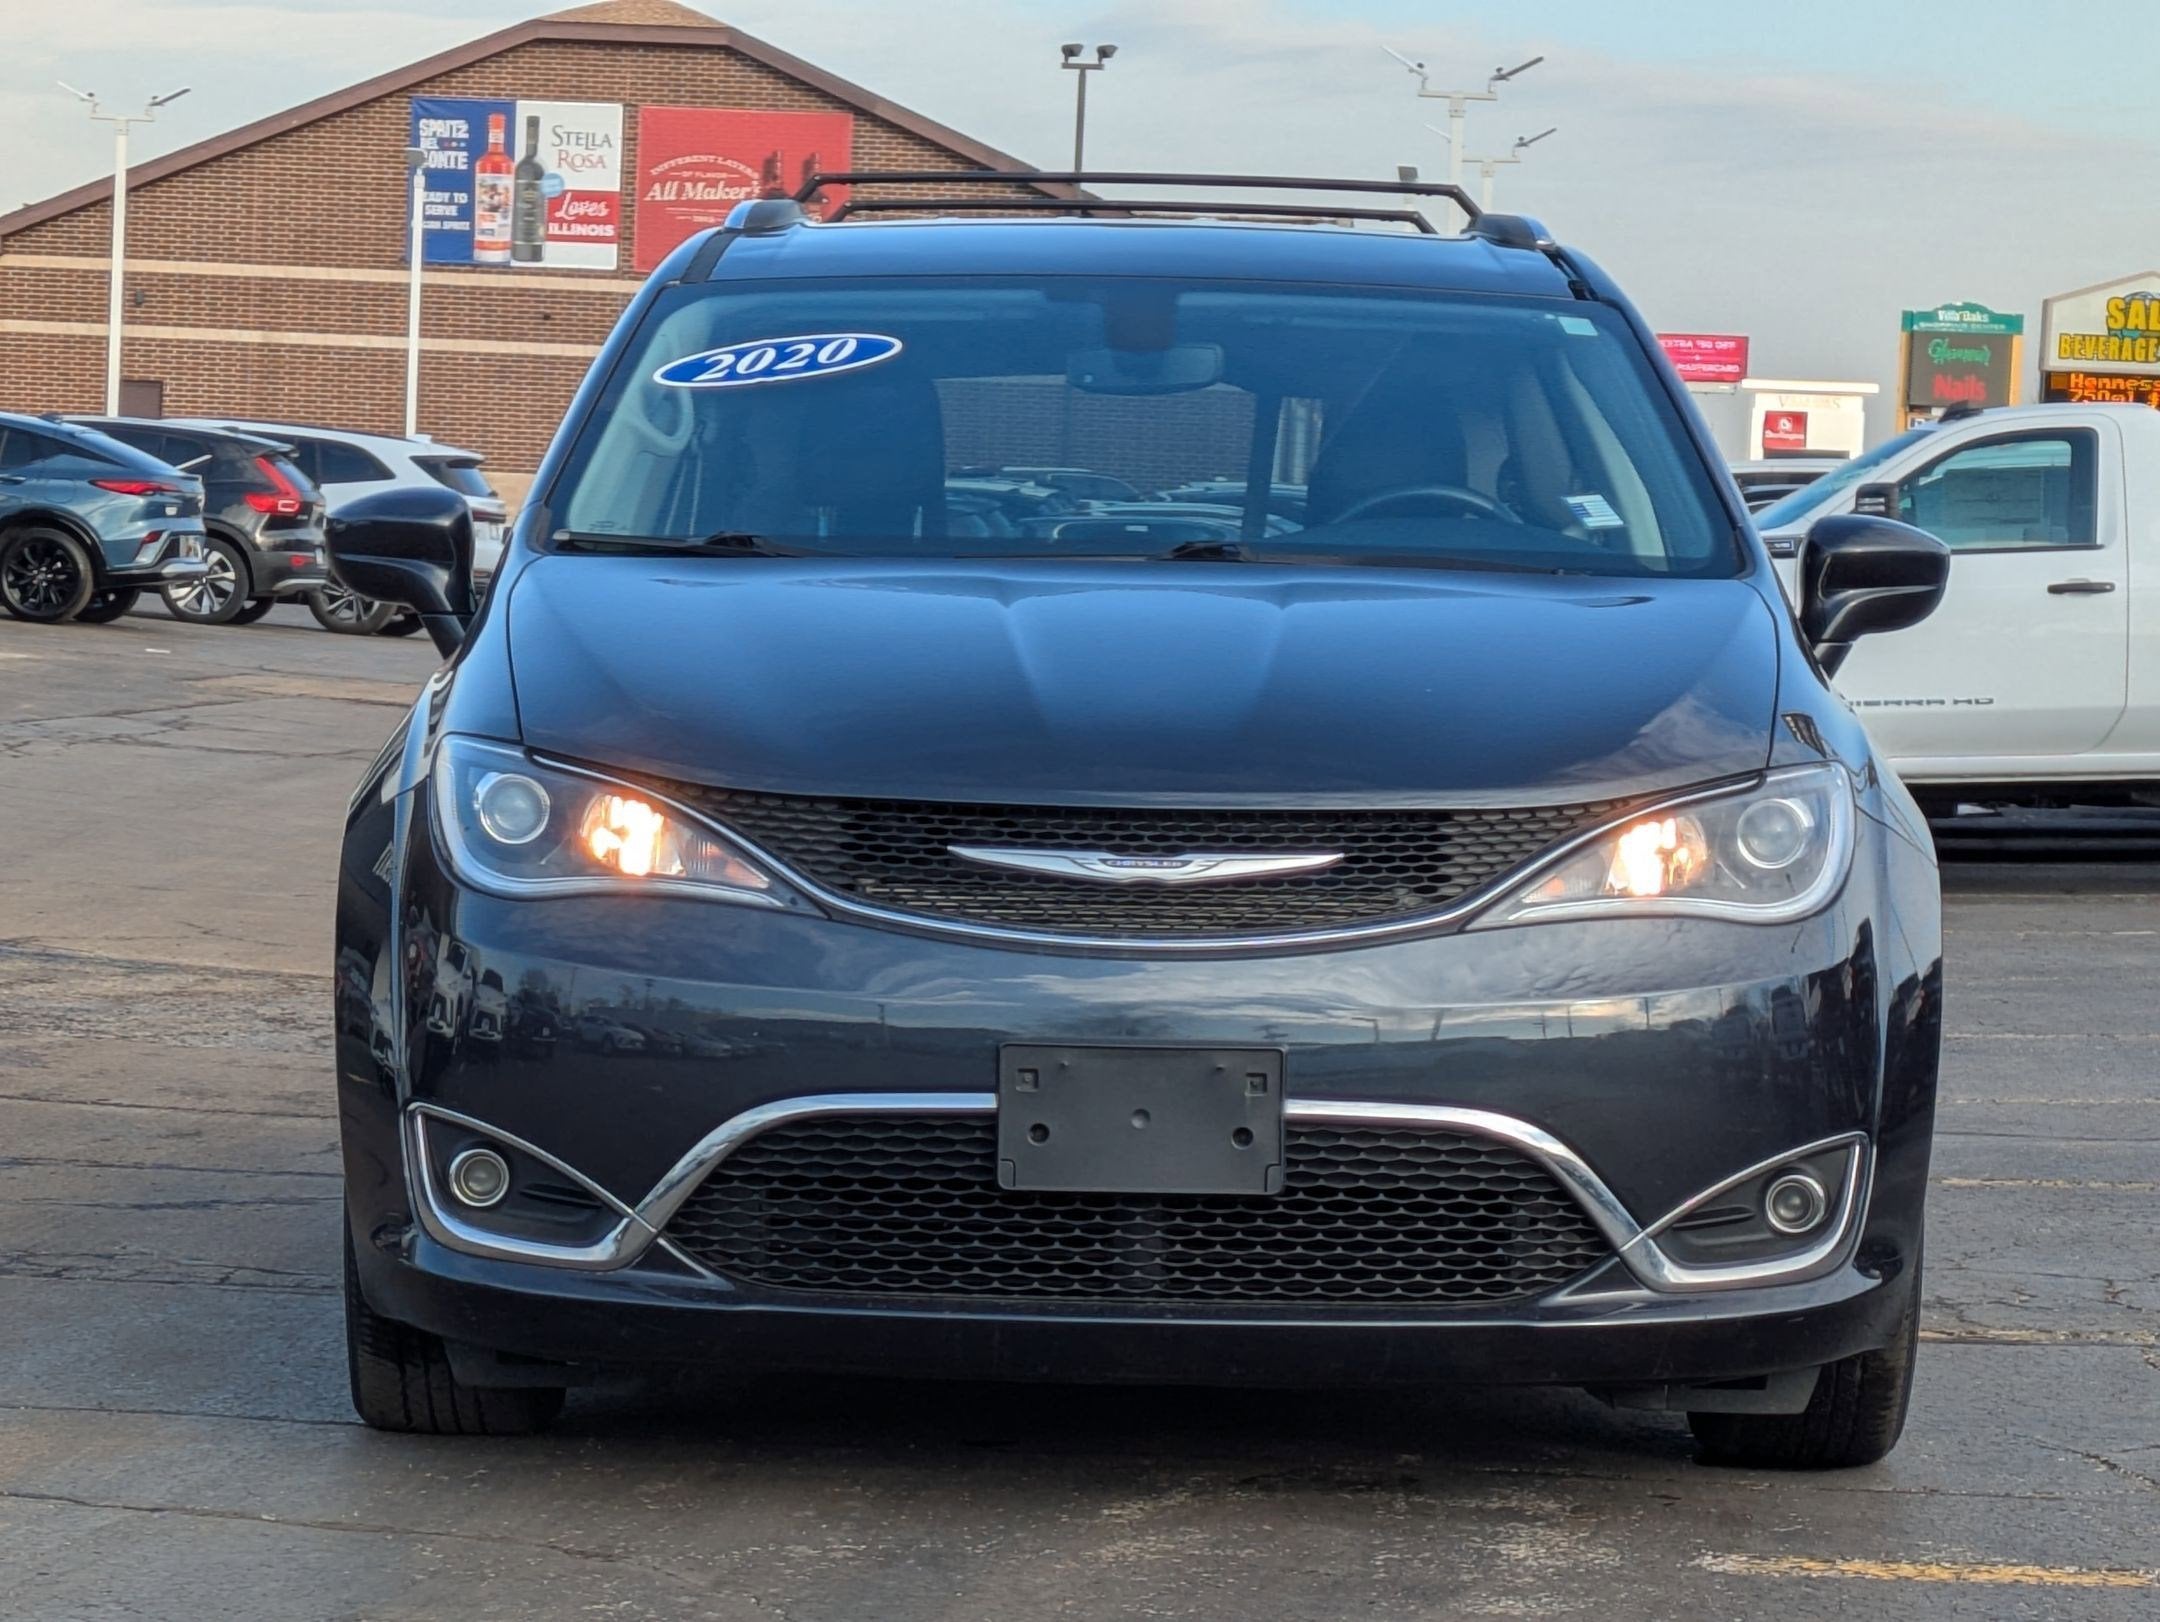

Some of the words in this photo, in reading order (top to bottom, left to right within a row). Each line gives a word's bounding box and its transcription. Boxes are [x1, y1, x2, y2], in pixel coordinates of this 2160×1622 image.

[419, 119, 469, 138] SPRITZ
[551, 124, 614, 150] STELLA
[557, 149, 608, 172] ROSA
[422, 192, 451, 203] EADY
[452, 193, 468, 204] TO
[643, 181, 680, 201] All
[554, 192, 611, 220] Loves
[547, 222, 616, 237] ILLINOIS
[691, 337, 857, 382] 2020
[2058, 333, 2159, 363] BEVERAGE
